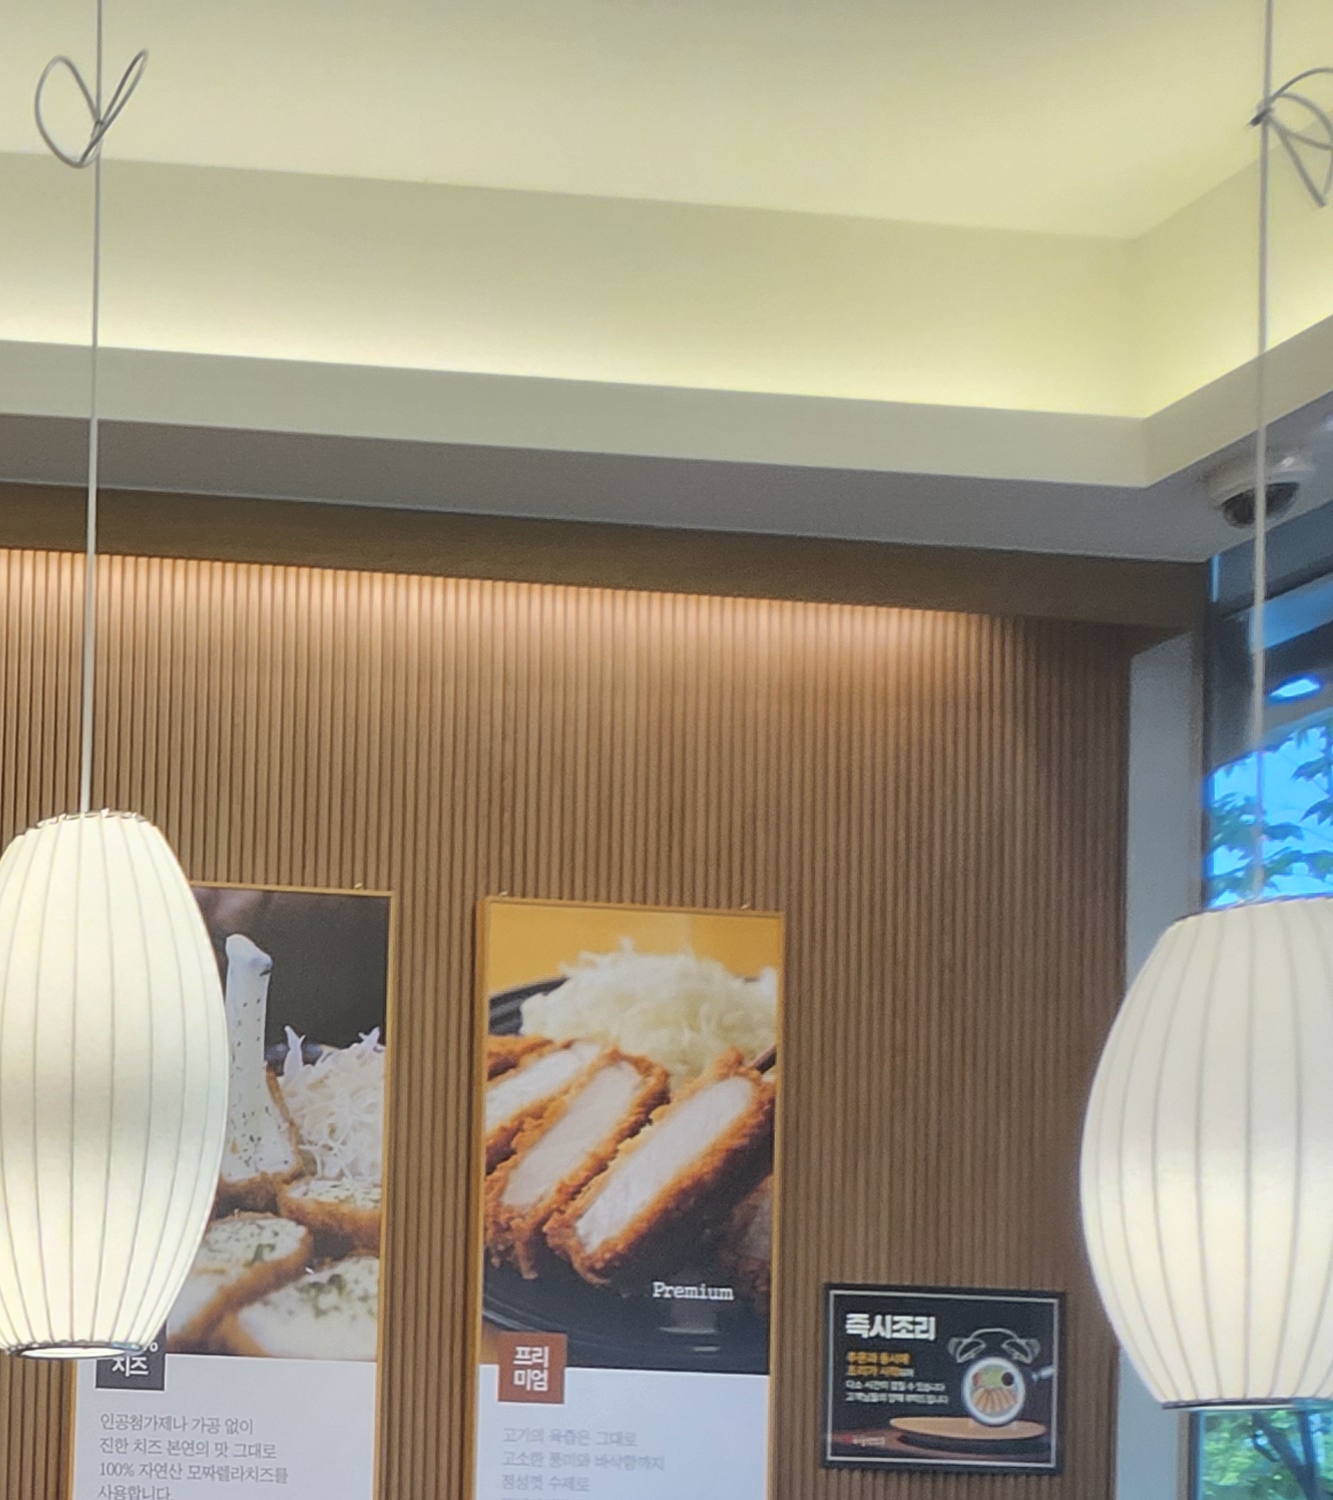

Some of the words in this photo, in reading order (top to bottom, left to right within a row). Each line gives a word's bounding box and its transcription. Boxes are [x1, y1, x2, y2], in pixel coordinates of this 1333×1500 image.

[652, 1281, 735, 1301] Premium
[845, 1313, 937, 1341] 즉시조리
[100, 1413, 187, 1433] 인공첨가제나
[191, 1416, 220, 1434] 가공
[225, 1417, 254, 1435] 없이
[502, 1427, 545, 1444] 고기의
[596, 1431, 638, 1447] 그대로
[99, 1437, 129, 1454] 진한
[133, 1438, 162, 1455] 치즈
[166, 1439, 210, 1457] 본연의
[214, 1441, 229, 1458] 맛
[233, 1442, 277, 1460] 그대로
[99, 1462, 135, 1477] 100%
[139, 1462, 183, 1480] 자연산
